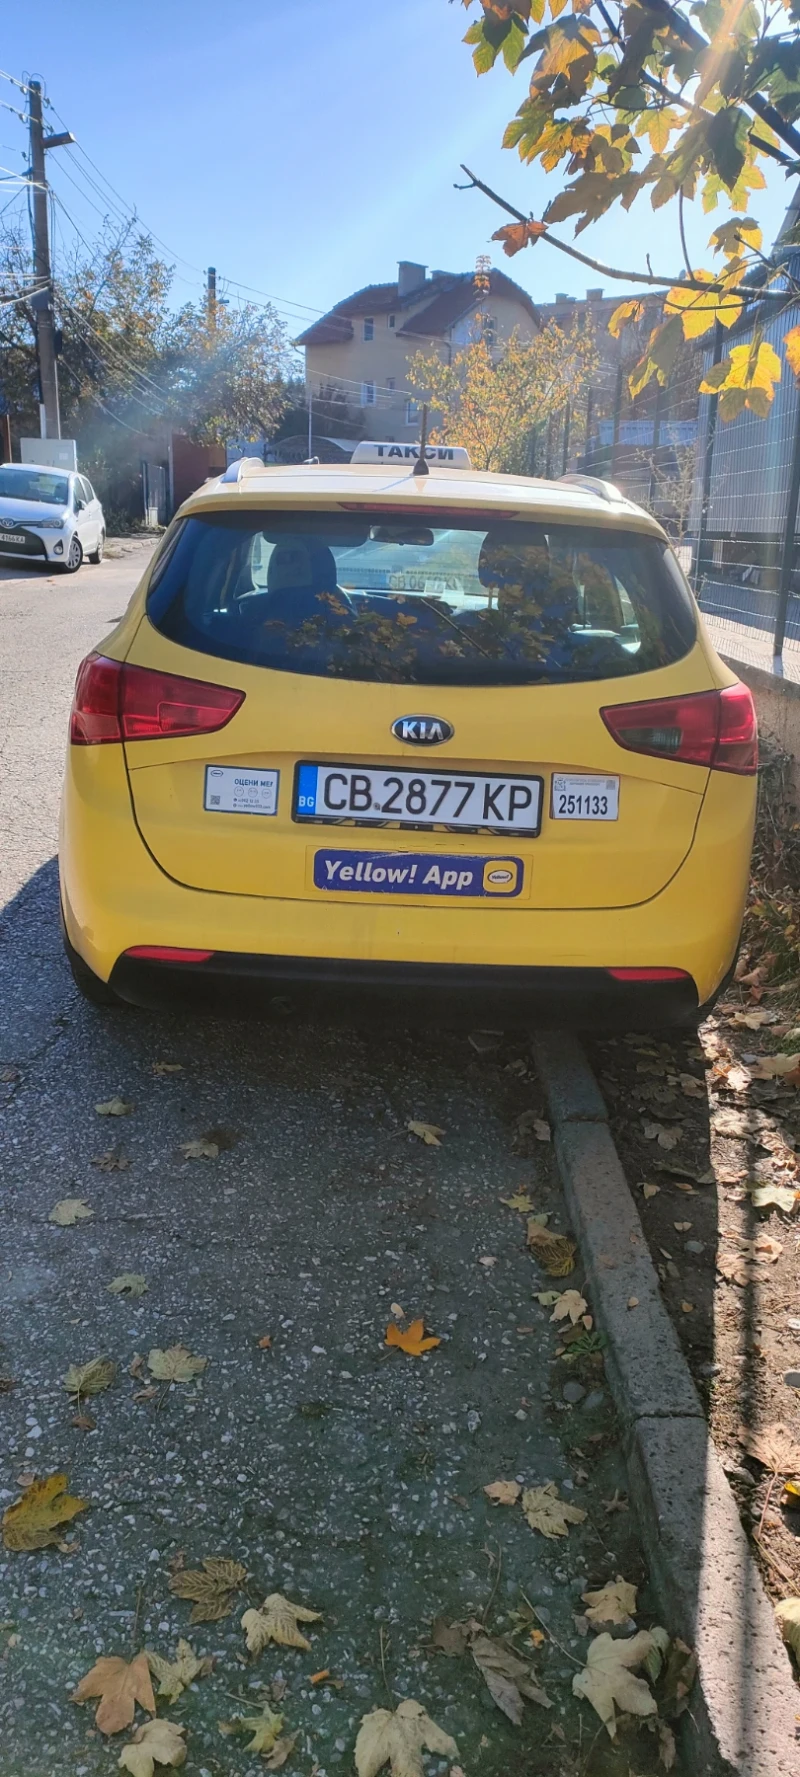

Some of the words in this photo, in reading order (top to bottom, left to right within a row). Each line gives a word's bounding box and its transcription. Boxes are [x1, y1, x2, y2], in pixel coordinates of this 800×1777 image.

[374, 444, 454, 460] ТАКСИ
[402, 721, 444, 740] KIA
[234, 778, 259, 787] ОЦЕНИ
[298, 796, 315, 807] BG
[323, 773, 372, 812] CB
[381, 777, 476, 818] 2877
[482, 783, 532, 822] KP
[558, 794, 608, 815] 251133
[325, 860, 418, 884] Yellow!
[422, 865, 474, 890] App
